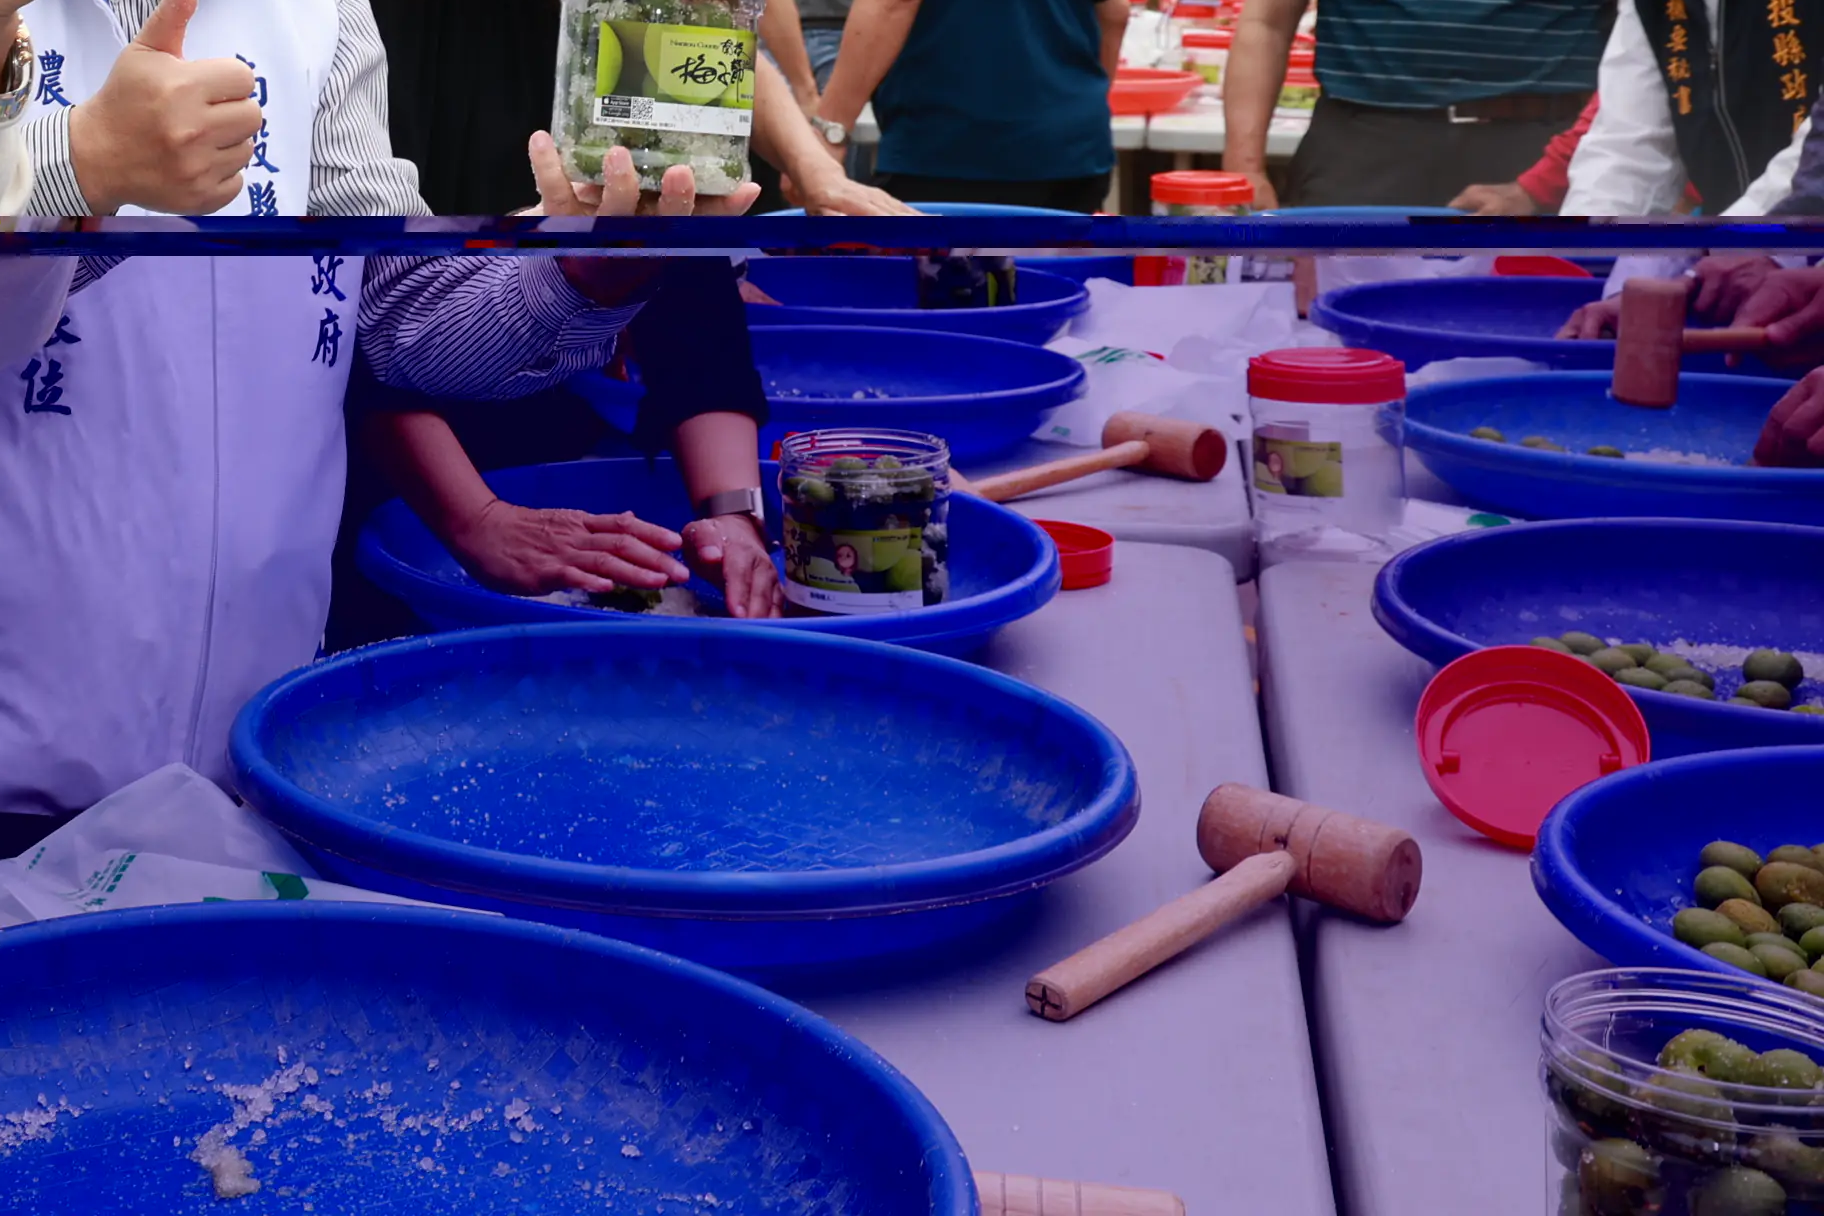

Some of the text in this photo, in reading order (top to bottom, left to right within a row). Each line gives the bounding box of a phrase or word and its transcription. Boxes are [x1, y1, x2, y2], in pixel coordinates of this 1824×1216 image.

[35, 49, 72, 106] 農
[671, 53, 745, 103] 梅子節
